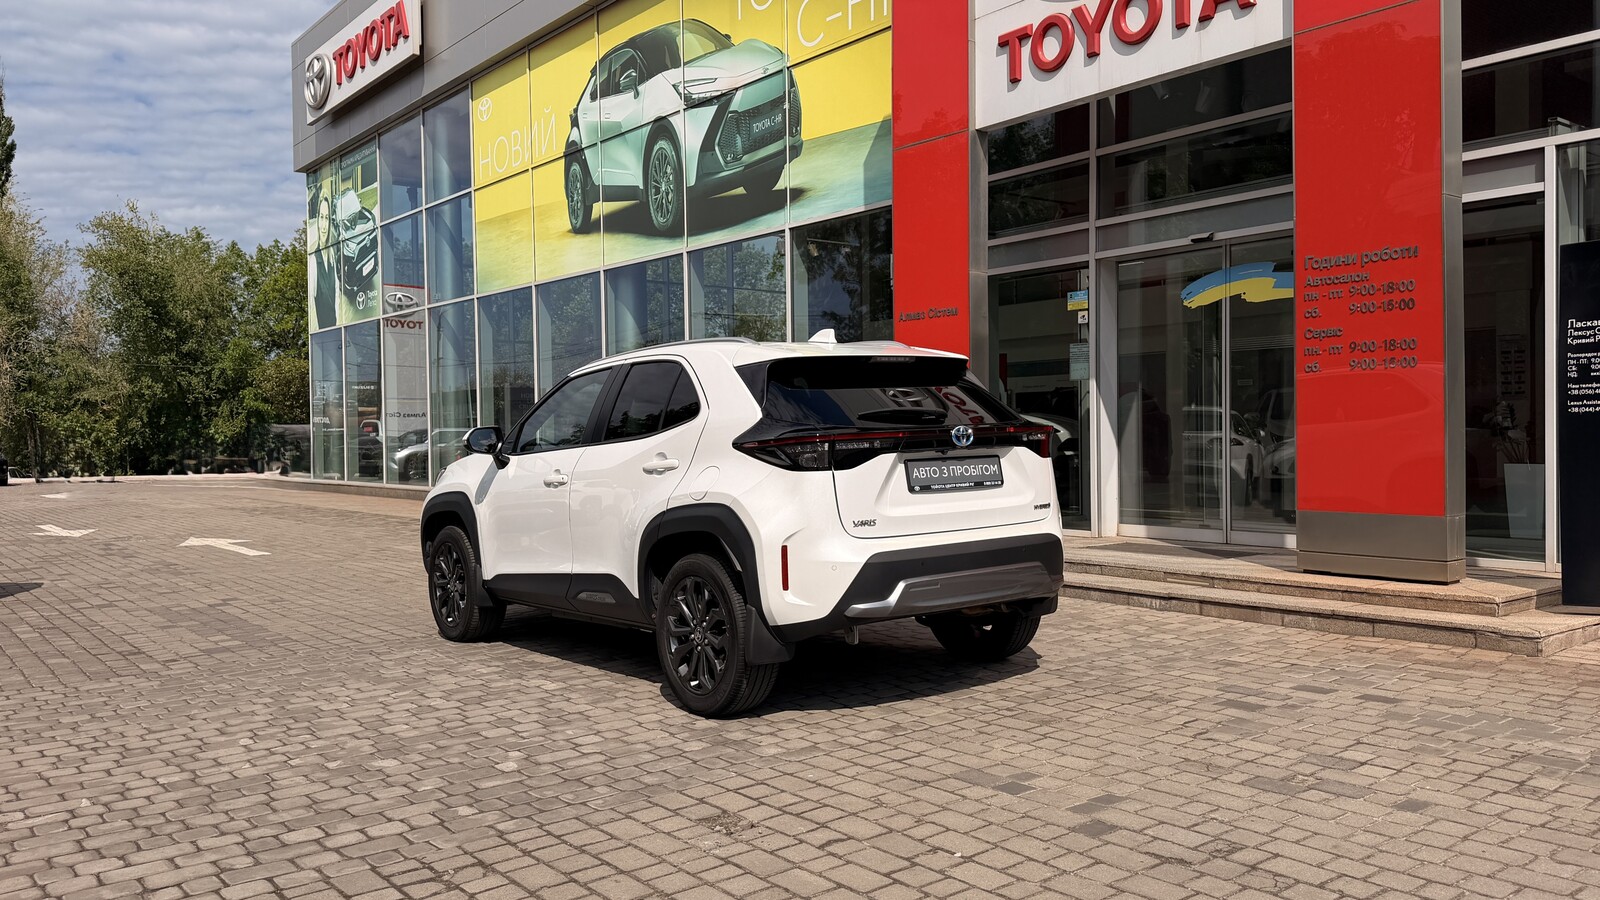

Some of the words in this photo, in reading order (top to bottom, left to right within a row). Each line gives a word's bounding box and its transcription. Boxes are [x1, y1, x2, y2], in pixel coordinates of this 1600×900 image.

[332, 0, 410, 86] TOYOTA
[753, 118, 770, 133] TOYOTA
[479, 105, 556, 181] НОВИЙ
[1304, 253, 1358, 271] Години
[1361, 245, 1419, 268] роботи
[1304, 271, 1370, 288] Автосалон
[1349, 279, 1416, 297] 9:00-18:00
[1304, 307, 1322, 319] сб.
[1349, 297, 1416, 315] 9:00-15:00
[1304, 326, 1344, 341] Сервіс
[1567, 328, 1595, 337] Лексус
[1567, 335, 1595, 346] Кривий
[1349, 337, 1417, 354] 9:00-18:00
[912, 466, 940, 479] АВТО
[941, 466, 948, 477] З
[950, 464, 999, 477] ПРОБІГОМ
[852, 518, 877, 528] YARIS
